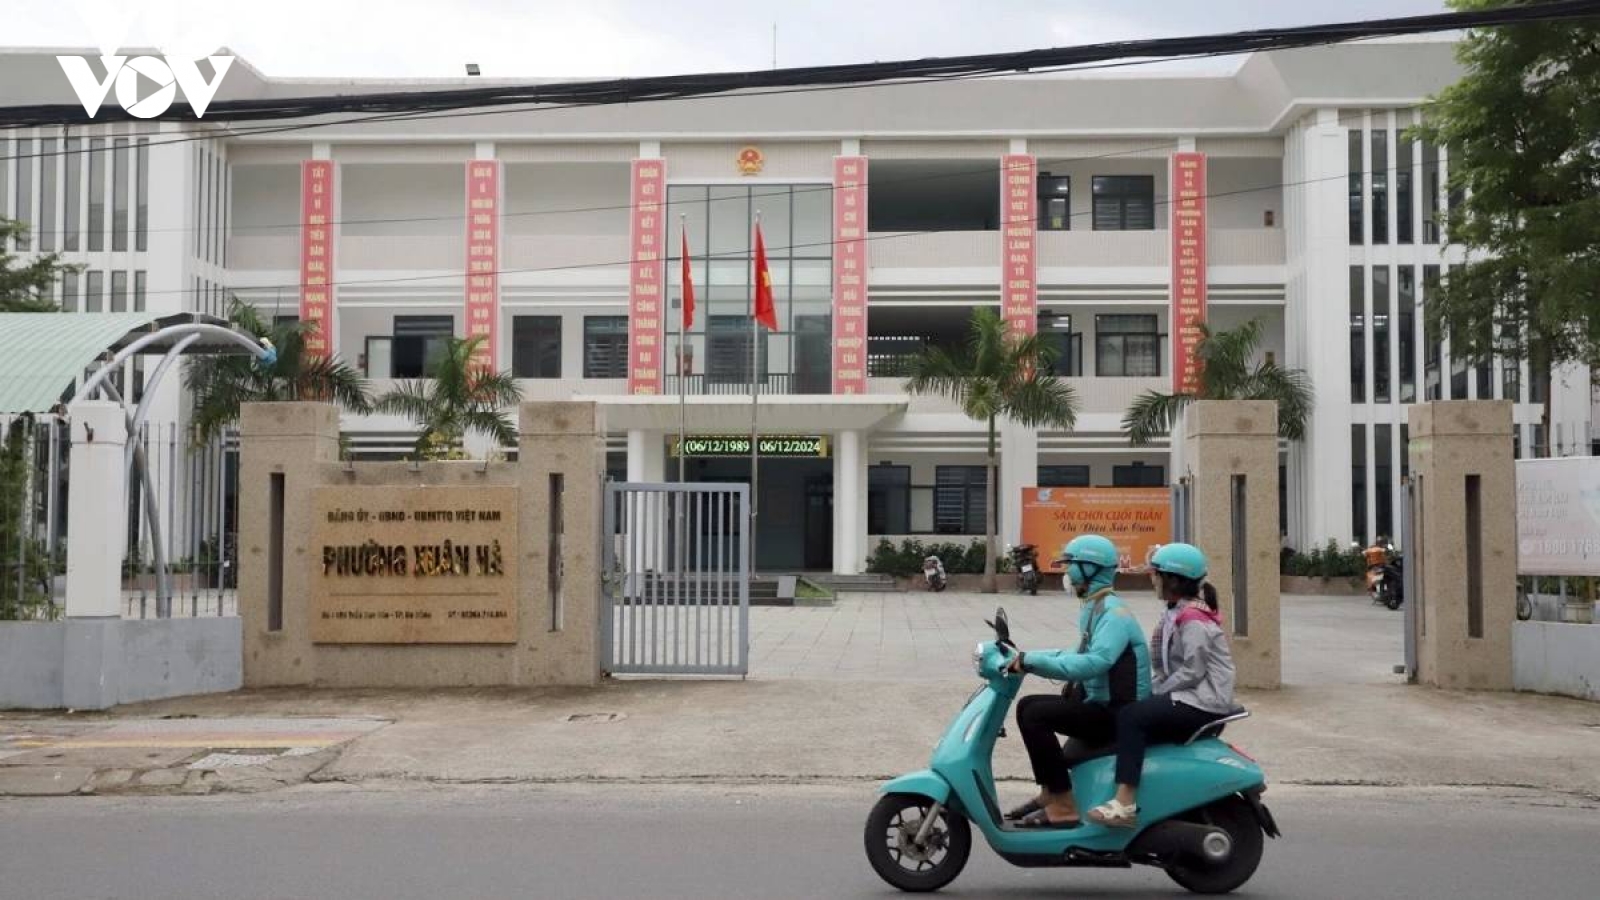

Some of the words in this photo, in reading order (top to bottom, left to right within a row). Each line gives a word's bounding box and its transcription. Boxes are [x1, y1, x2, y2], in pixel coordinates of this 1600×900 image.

[312, 166, 325, 179] TẤT
[313, 181, 323, 193] CẢ
[1008, 175, 1030, 187] CỘNG
[642, 182, 655, 195] KẾT
[641, 216, 654, 229] KẾT
[636, 299, 657, 312] CÔNG
[759, 441, 821, 453] 06/12/2024
[455, 509, 476, 524] VIỆT
[478, 511, 501, 522] NAM
[322, 538, 406, 577] PHƯỜNG
[413, 539, 469, 577] XUÂN
